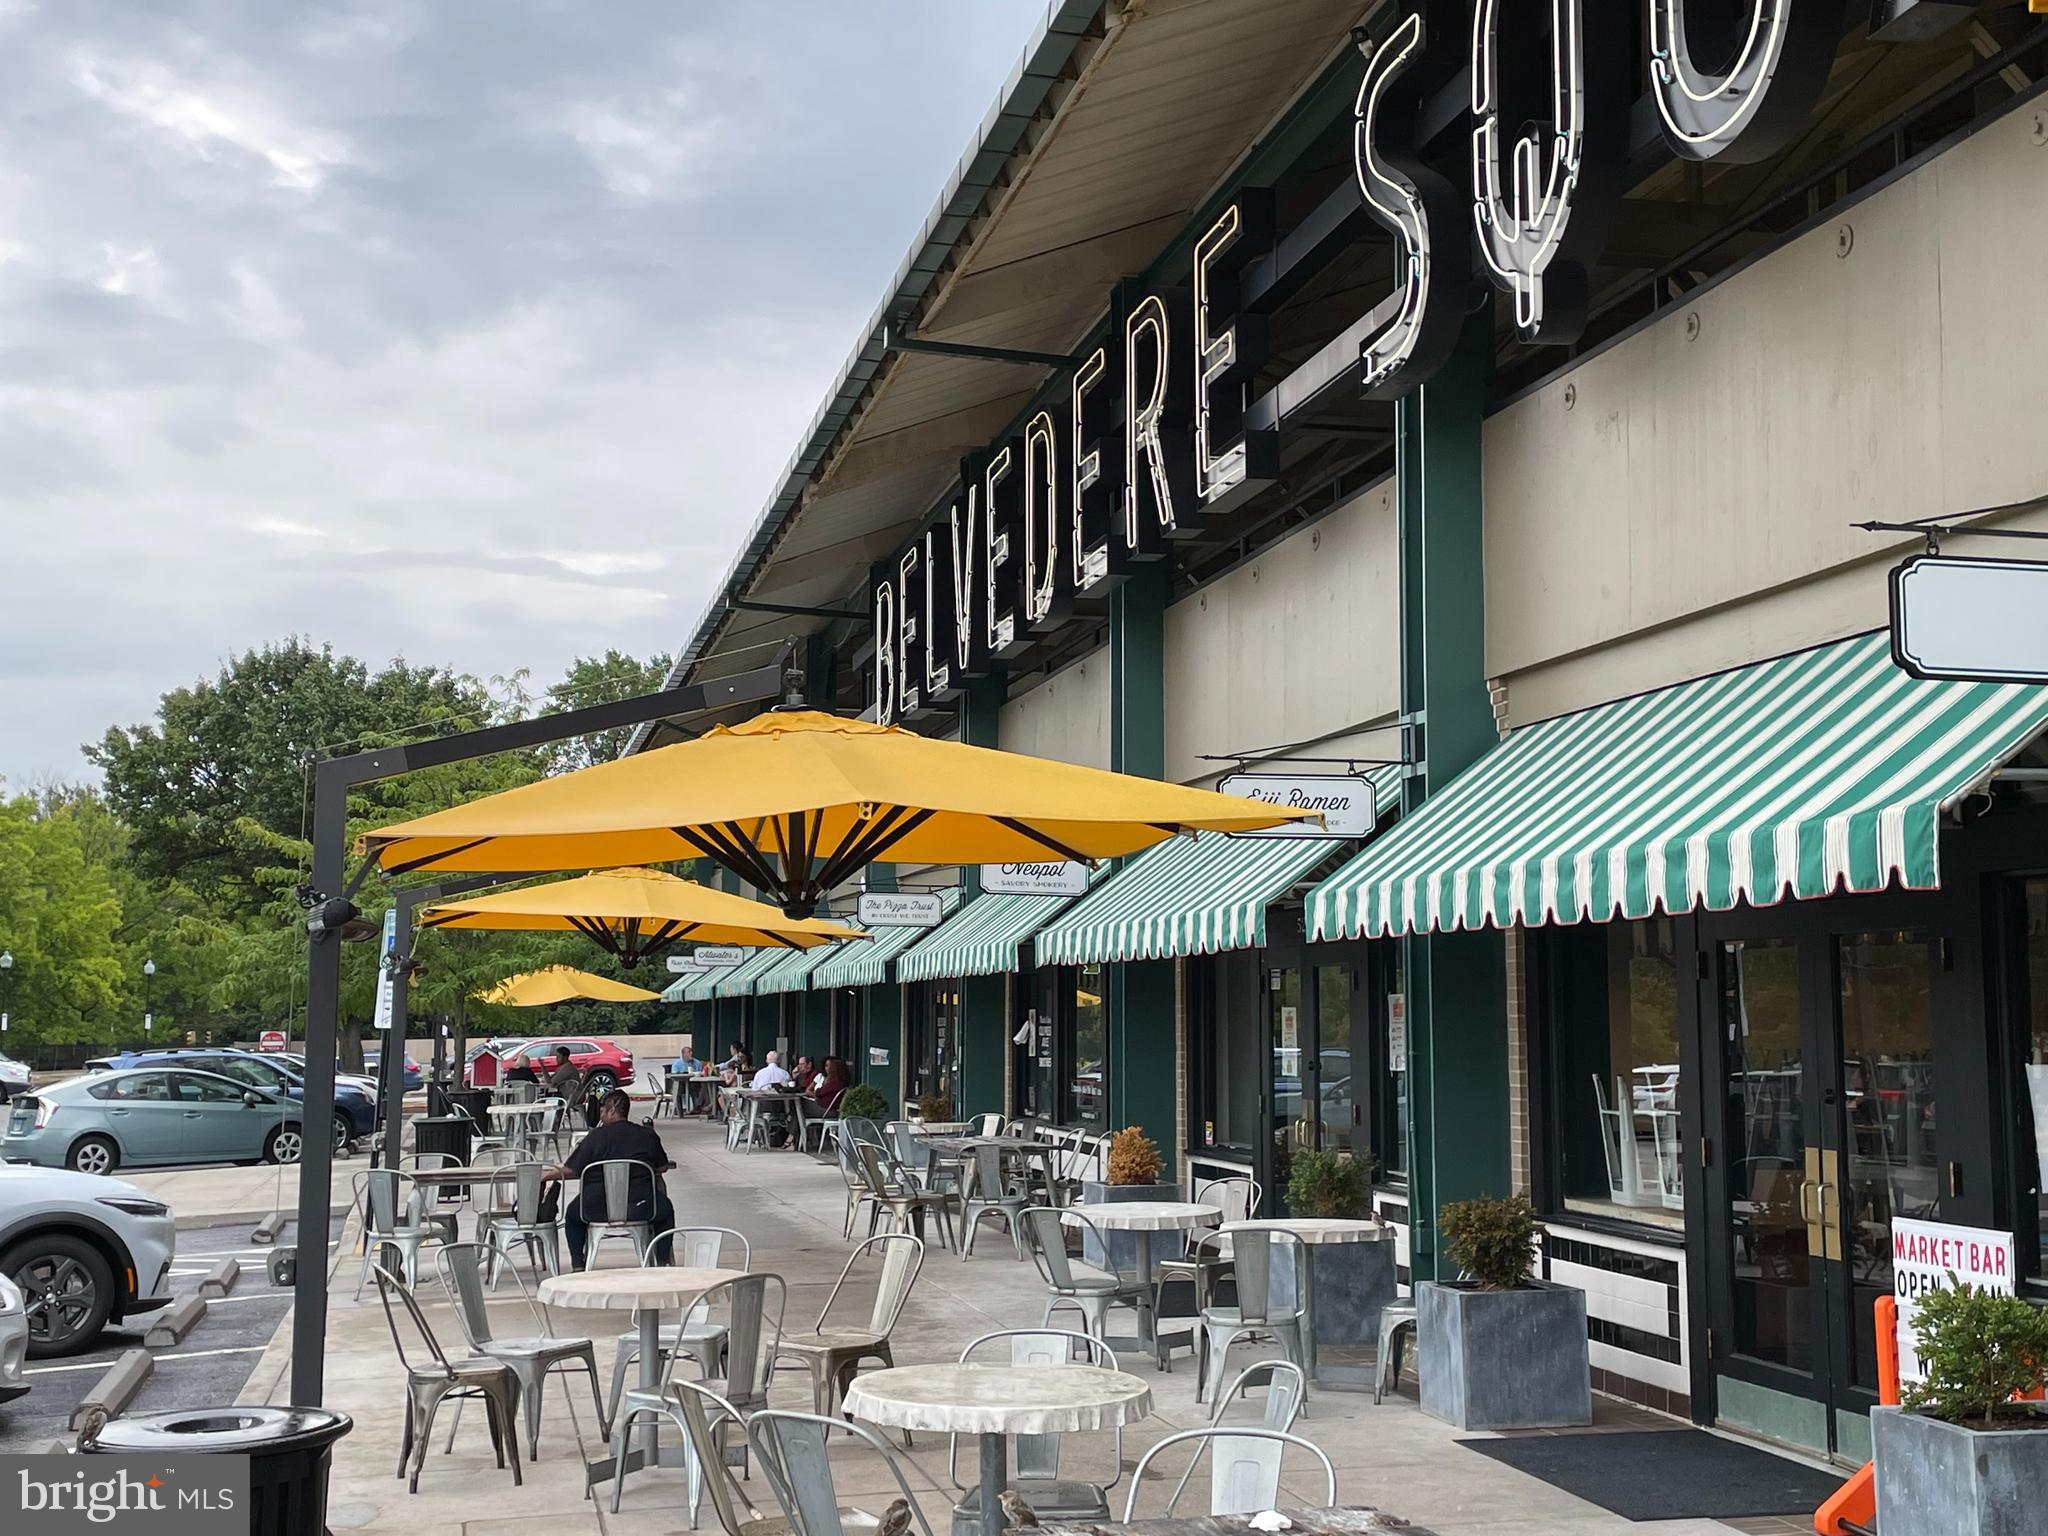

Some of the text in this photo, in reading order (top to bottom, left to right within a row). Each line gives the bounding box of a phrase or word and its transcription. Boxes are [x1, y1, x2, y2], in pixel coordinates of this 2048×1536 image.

[875, 203, 1248, 728] BELVEDERE
[1287, 788, 1351, 812] Ramen
[1001, 861, 1067, 880] Neopol
[1001, 879, 1068, 889] SAVORY SMOKERY
[865, 899, 935, 913] The Pizza Trust
[1894, 1231, 2006, 1276] MARKET BAR
[1897, 1269, 1941, 1299] OPEN
